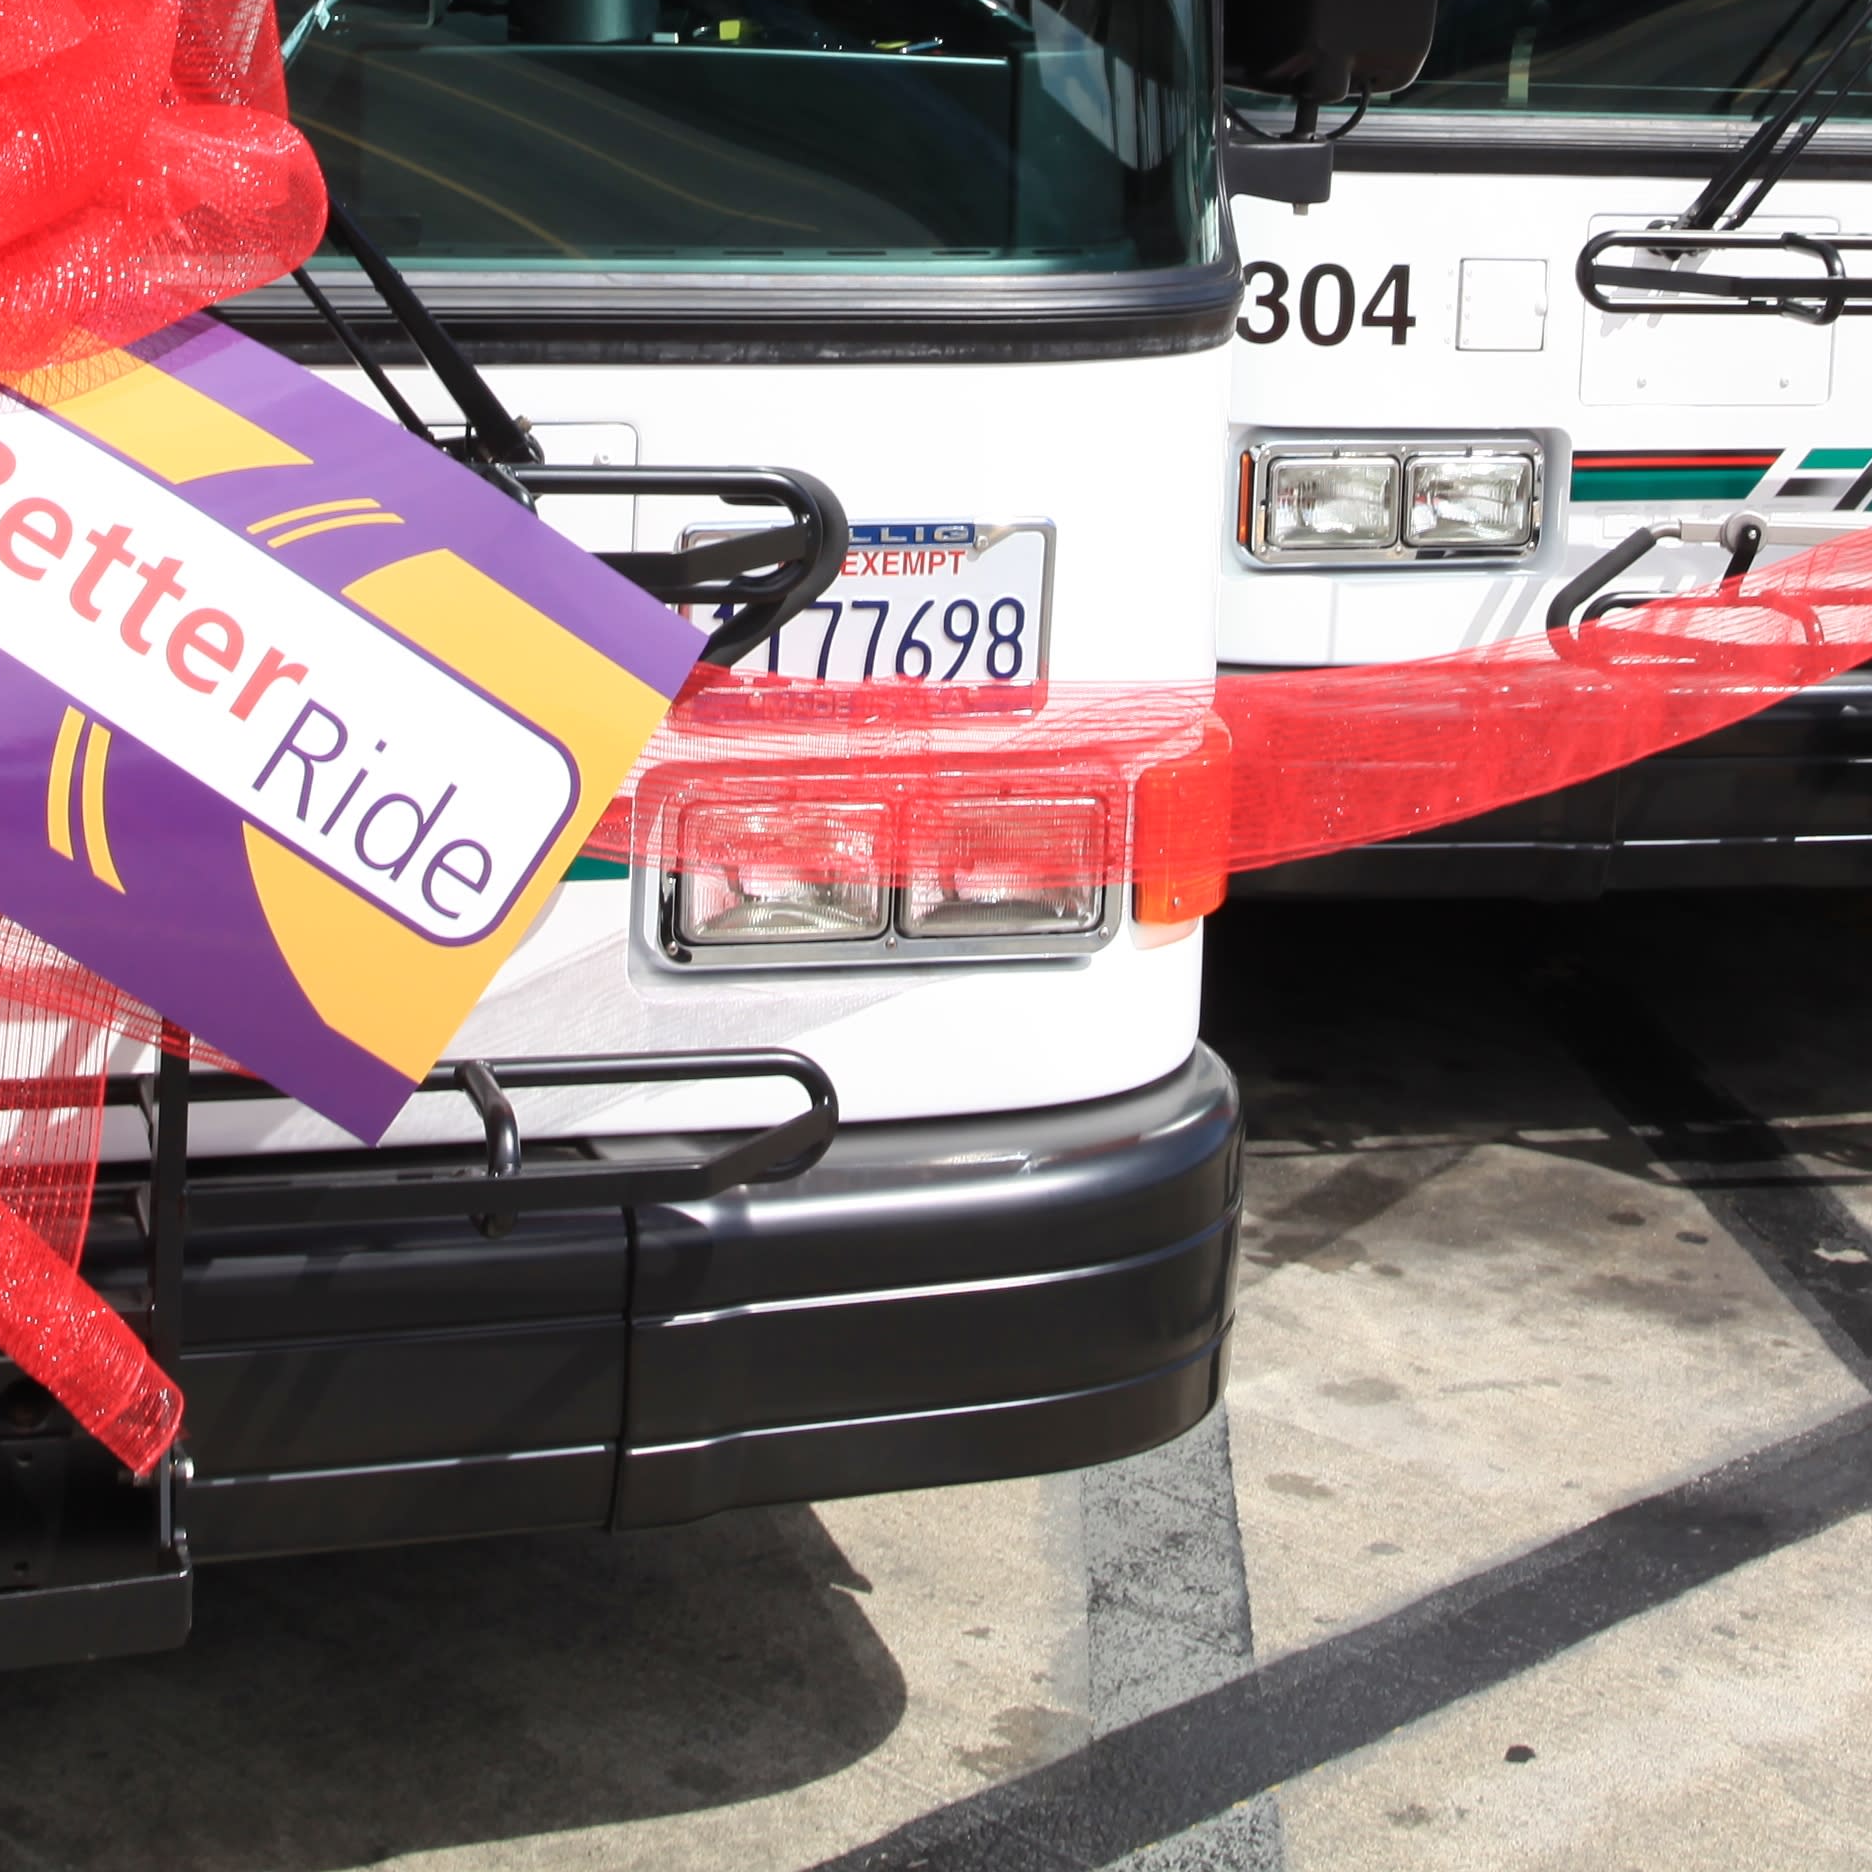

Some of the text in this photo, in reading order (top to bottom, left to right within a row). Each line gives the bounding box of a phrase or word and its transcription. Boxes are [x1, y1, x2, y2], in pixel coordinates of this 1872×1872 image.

[1236, 260, 1417, 346] 304
[840, 550, 967, 576] EXEMPT
[848, 526, 969, 543] LLIG
[712, 597, 1027, 683] 177698
[251, 697, 493, 921] Ride
